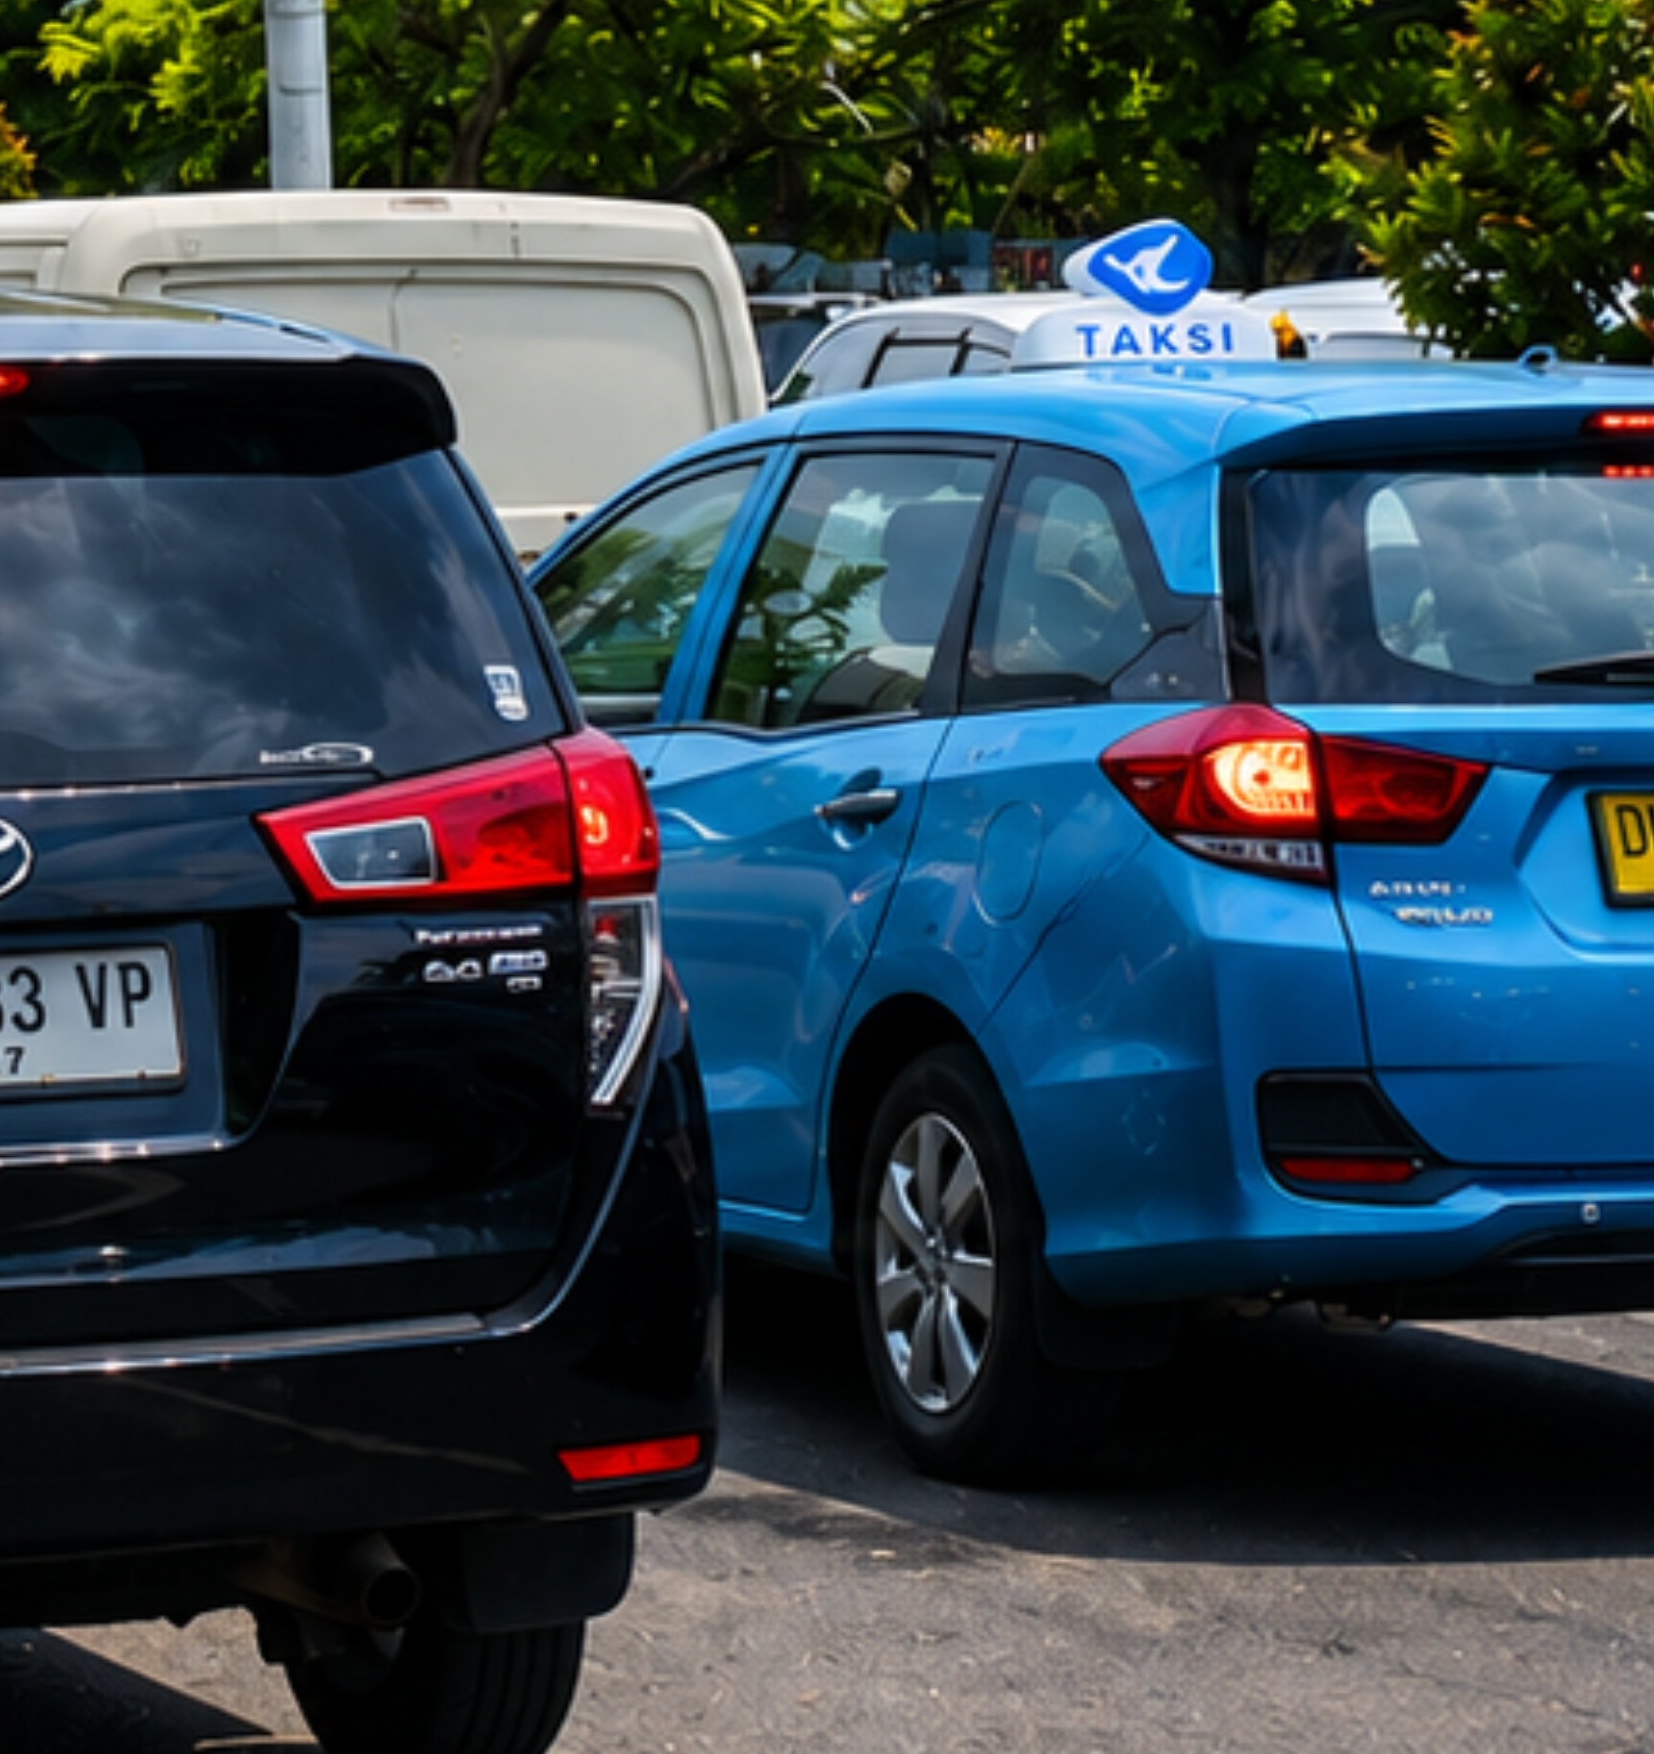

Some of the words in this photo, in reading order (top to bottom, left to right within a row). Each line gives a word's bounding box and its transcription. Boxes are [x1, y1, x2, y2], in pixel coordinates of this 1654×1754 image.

[1075, 321, 1233, 358] TAKSI
[1615, 803, 1654, 857] D
[75, 960, 152, 1029] VP
